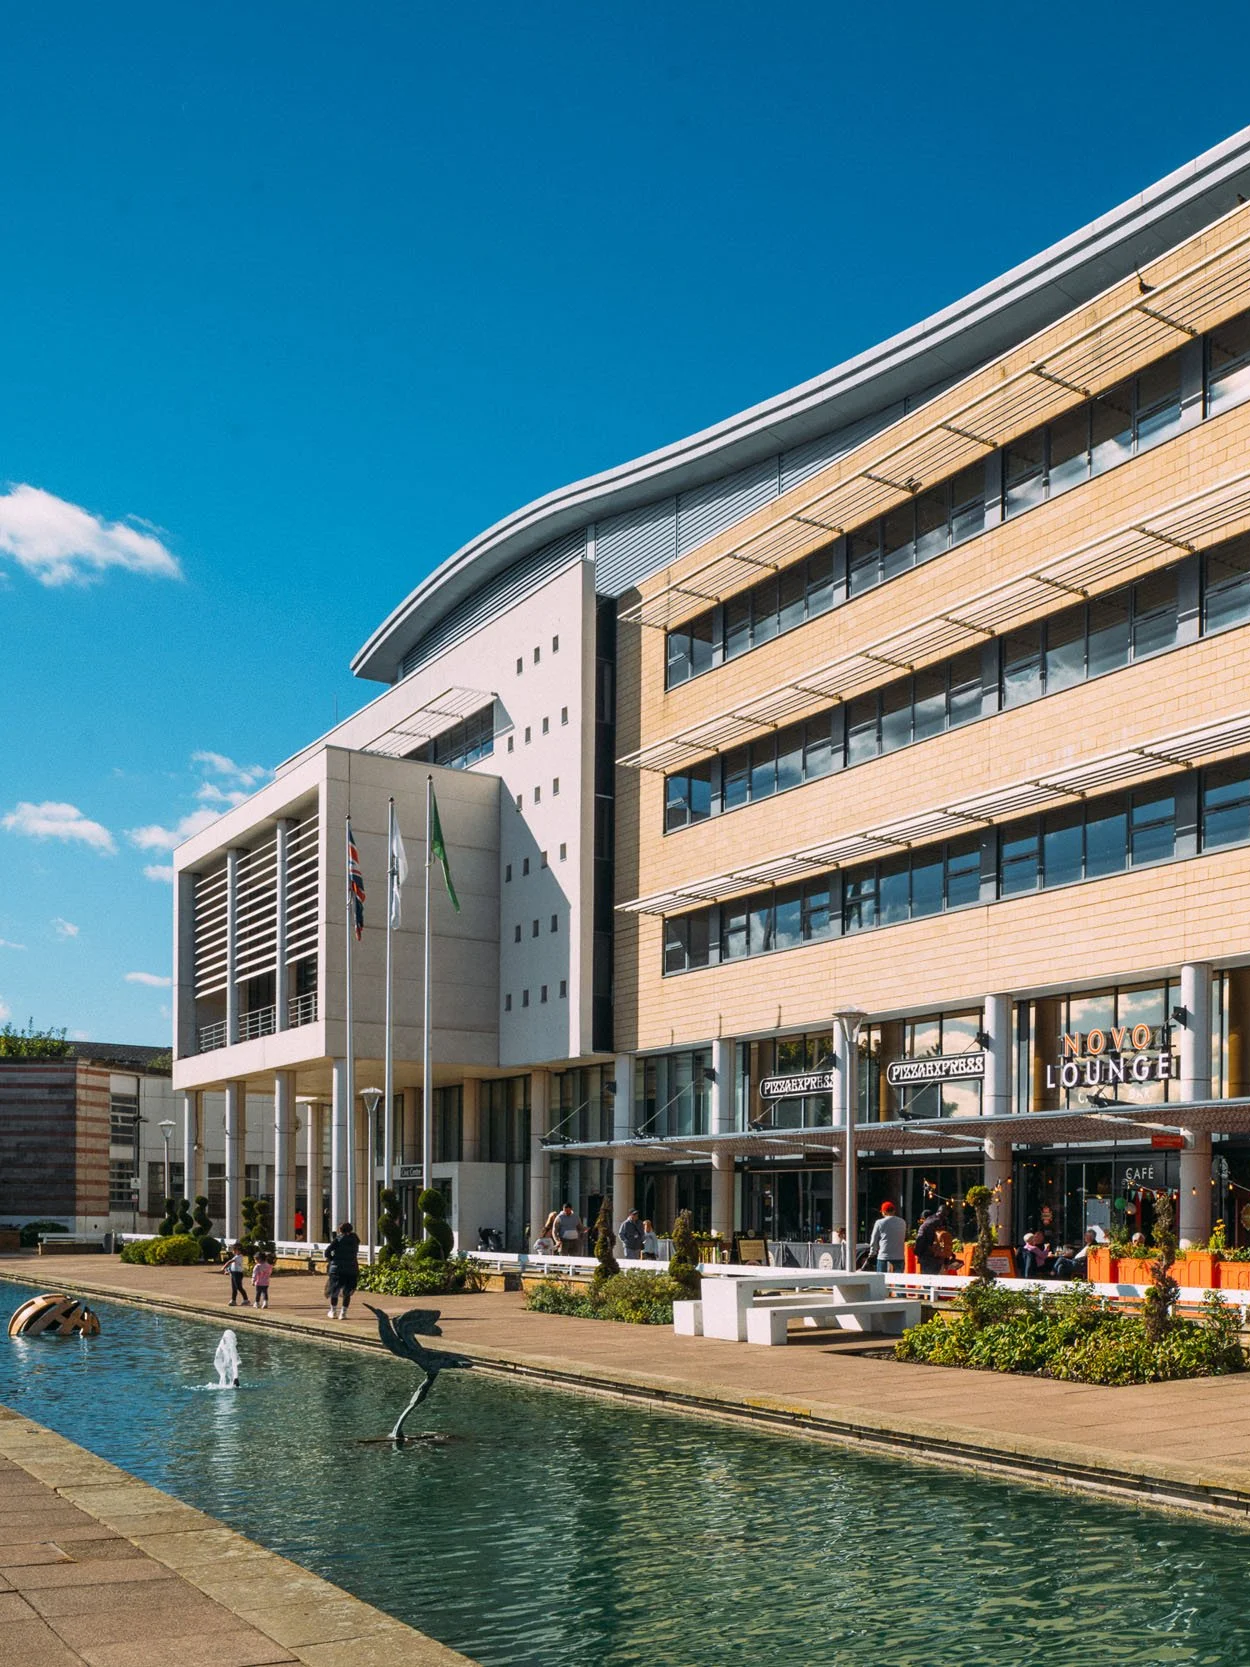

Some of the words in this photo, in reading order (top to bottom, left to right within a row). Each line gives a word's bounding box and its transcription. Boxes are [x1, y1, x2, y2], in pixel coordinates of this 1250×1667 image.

[1064, 1023, 1151, 1057] NOVO
[892, 1057, 984, 1080] PIZZAEXPRESS
[1046, 1053, 1169, 1089] LOUNGE
[1125, 1164, 1154, 1179] CAFÉ
